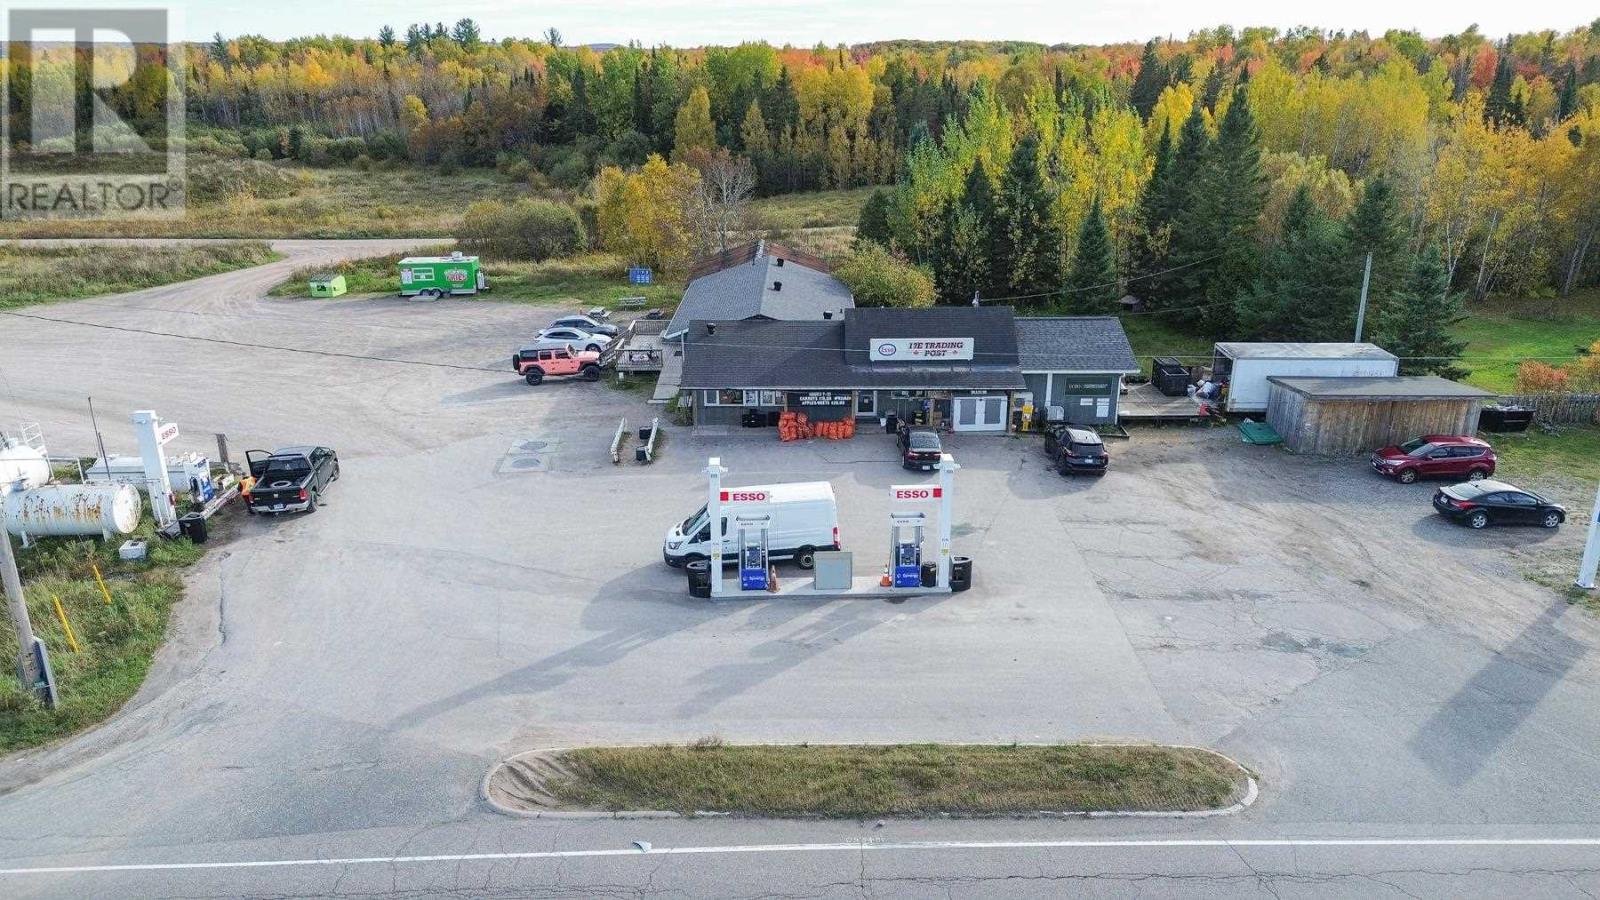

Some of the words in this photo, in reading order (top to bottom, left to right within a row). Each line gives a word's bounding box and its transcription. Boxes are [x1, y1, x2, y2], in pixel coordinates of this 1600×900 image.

[161, 426, 177, 440] ESSO
[732, 493, 766, 501] ESSO
[896, 490, 929, 499] ESSO
